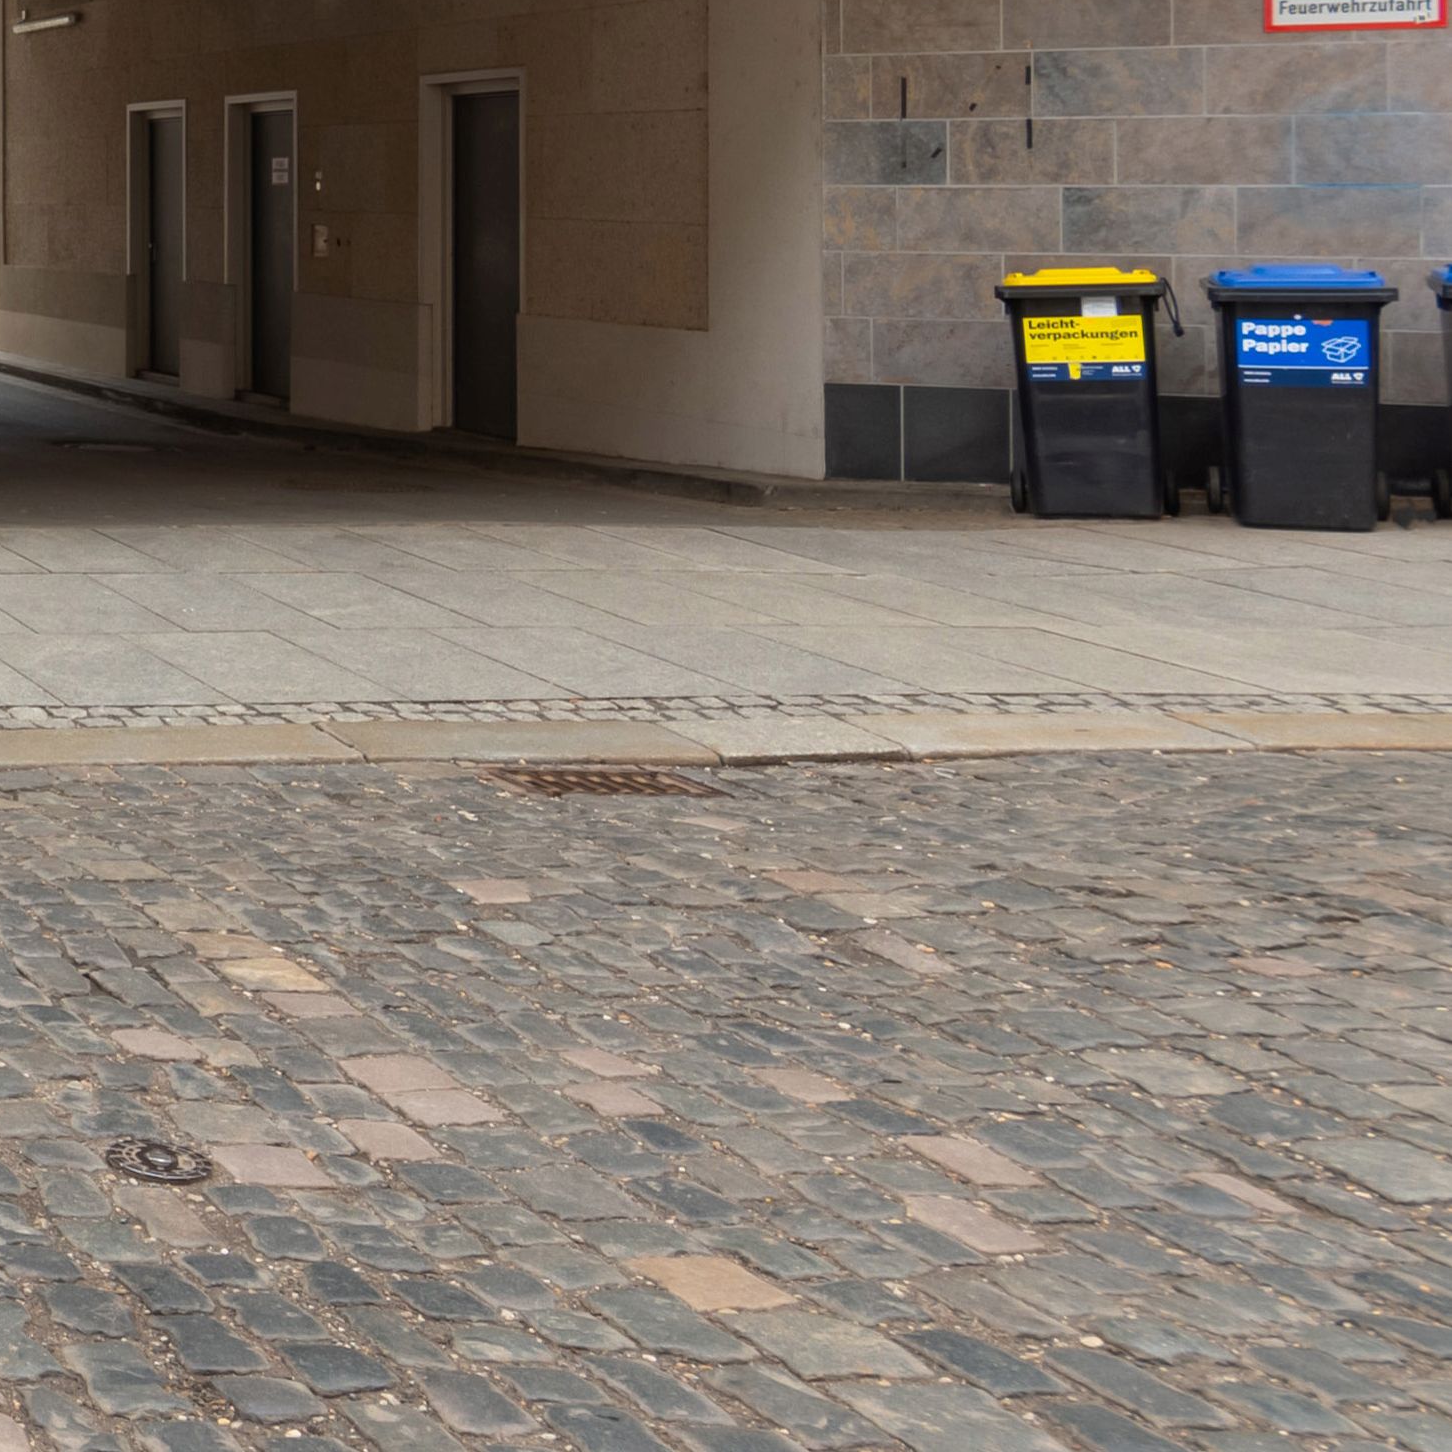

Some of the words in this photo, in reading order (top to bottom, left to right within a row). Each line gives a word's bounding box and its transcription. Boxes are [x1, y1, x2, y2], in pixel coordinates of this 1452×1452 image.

[1028, 318, 1080, 330] Leicht-
[1241, 321, 1307, 338] Pappe
[1028, 329, 1139, 341] verpackungen
[1242, 338, 1310, 355] Papier
